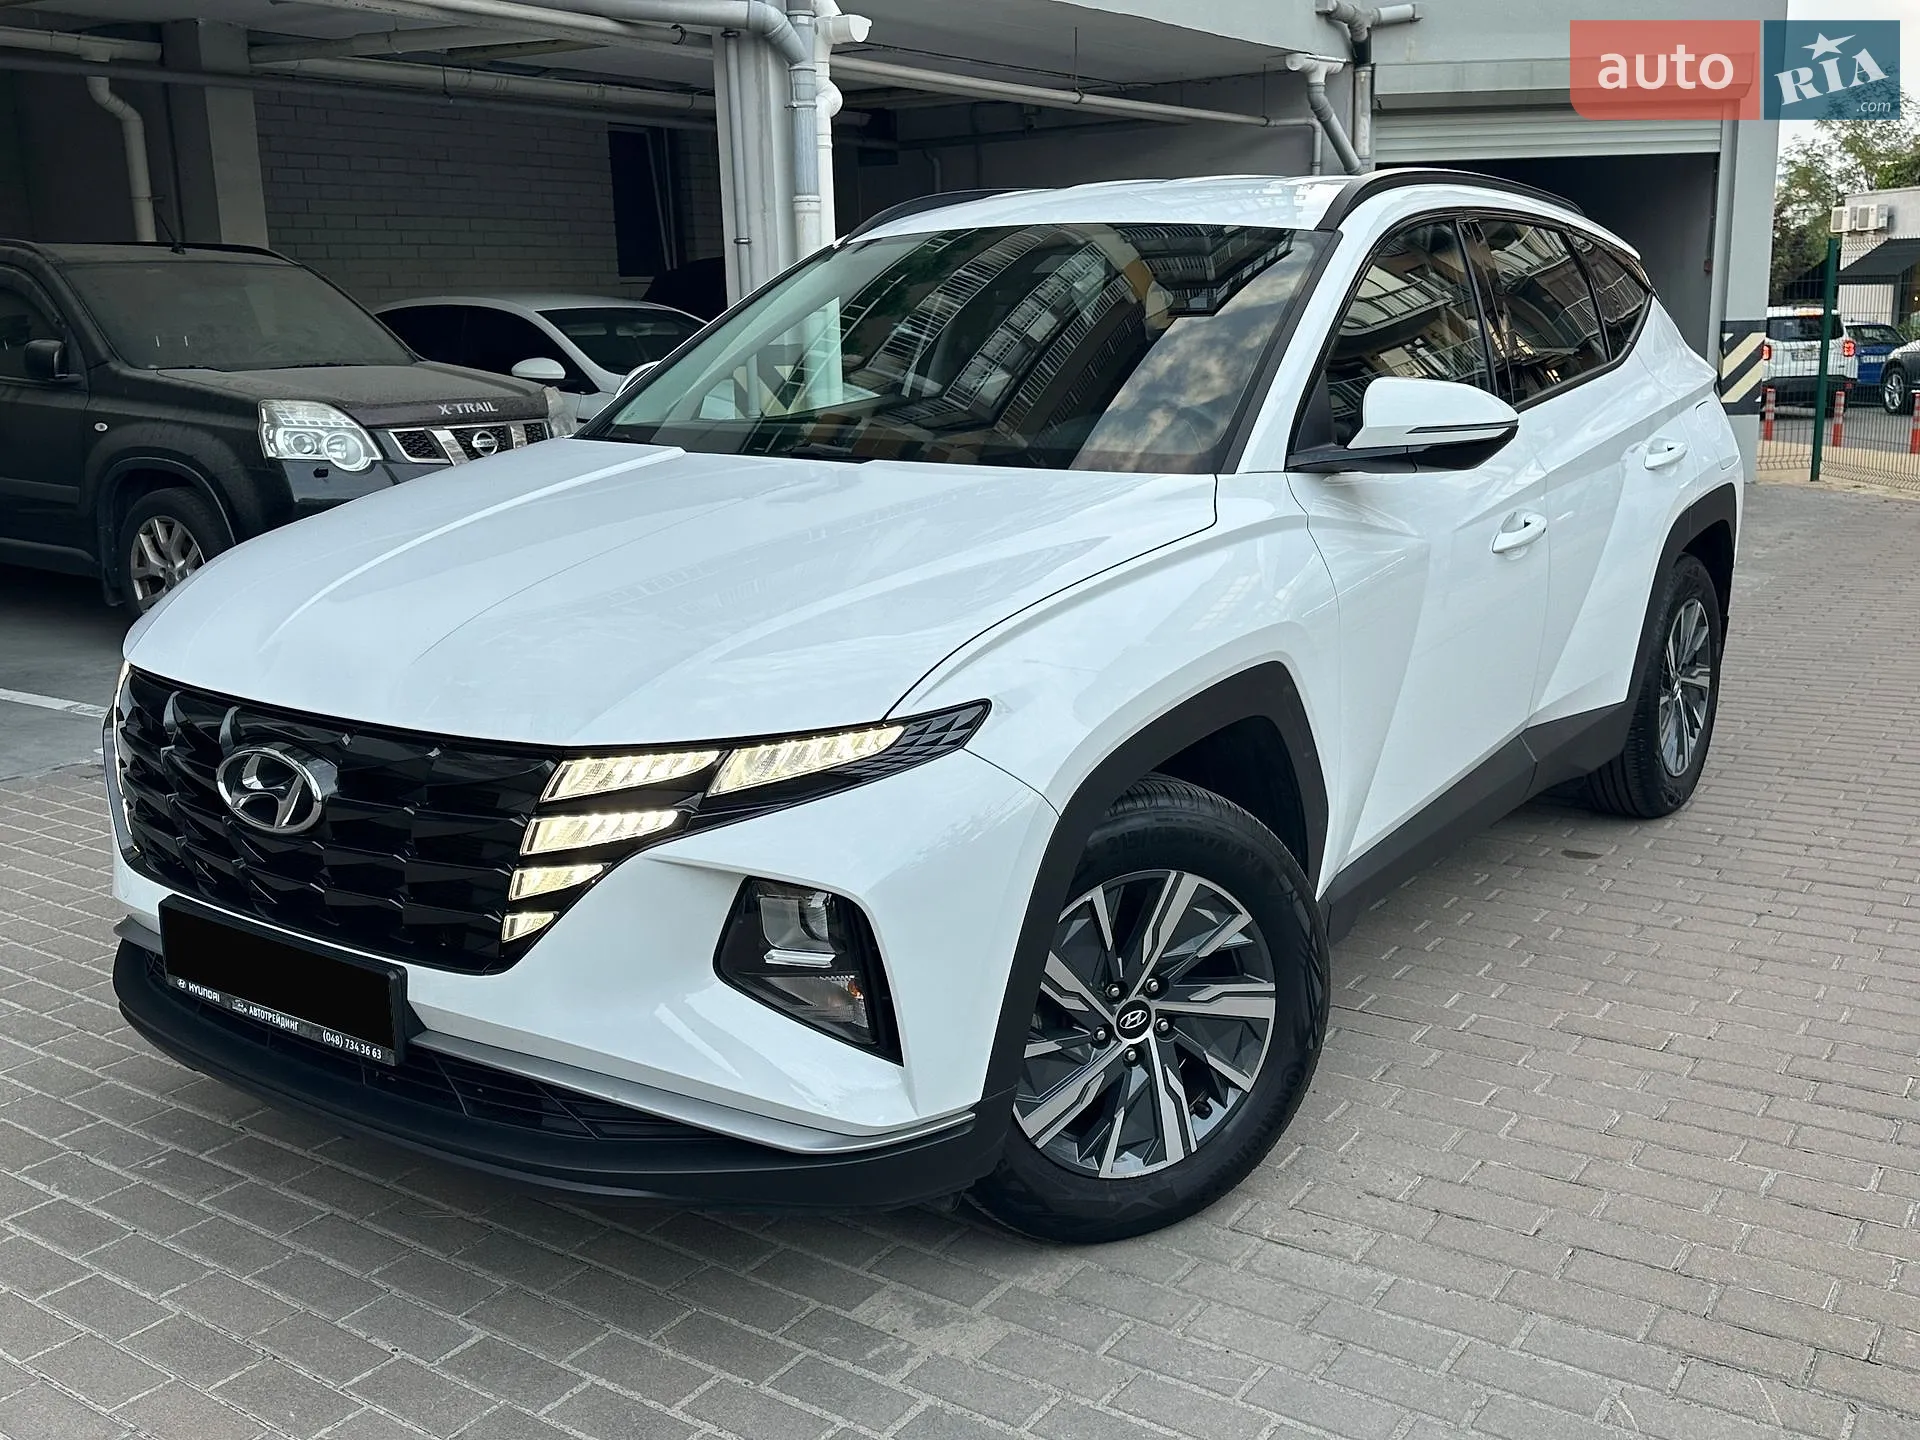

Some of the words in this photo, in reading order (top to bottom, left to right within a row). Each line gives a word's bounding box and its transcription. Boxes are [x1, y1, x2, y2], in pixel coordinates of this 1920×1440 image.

[437, 401, 499, 415] X-TRAIL
[188, 981, 220, 1003] HYUNDAI
[248, 1005, 299, 1032] АВТОТРЕЙДИНГ
[322, 1029, 344, 1048] (048)
[345, 1038, 359, 1052] 734
[360, 1043, 371, 1056] 36
[371, 1047, 382, 1060] 63
